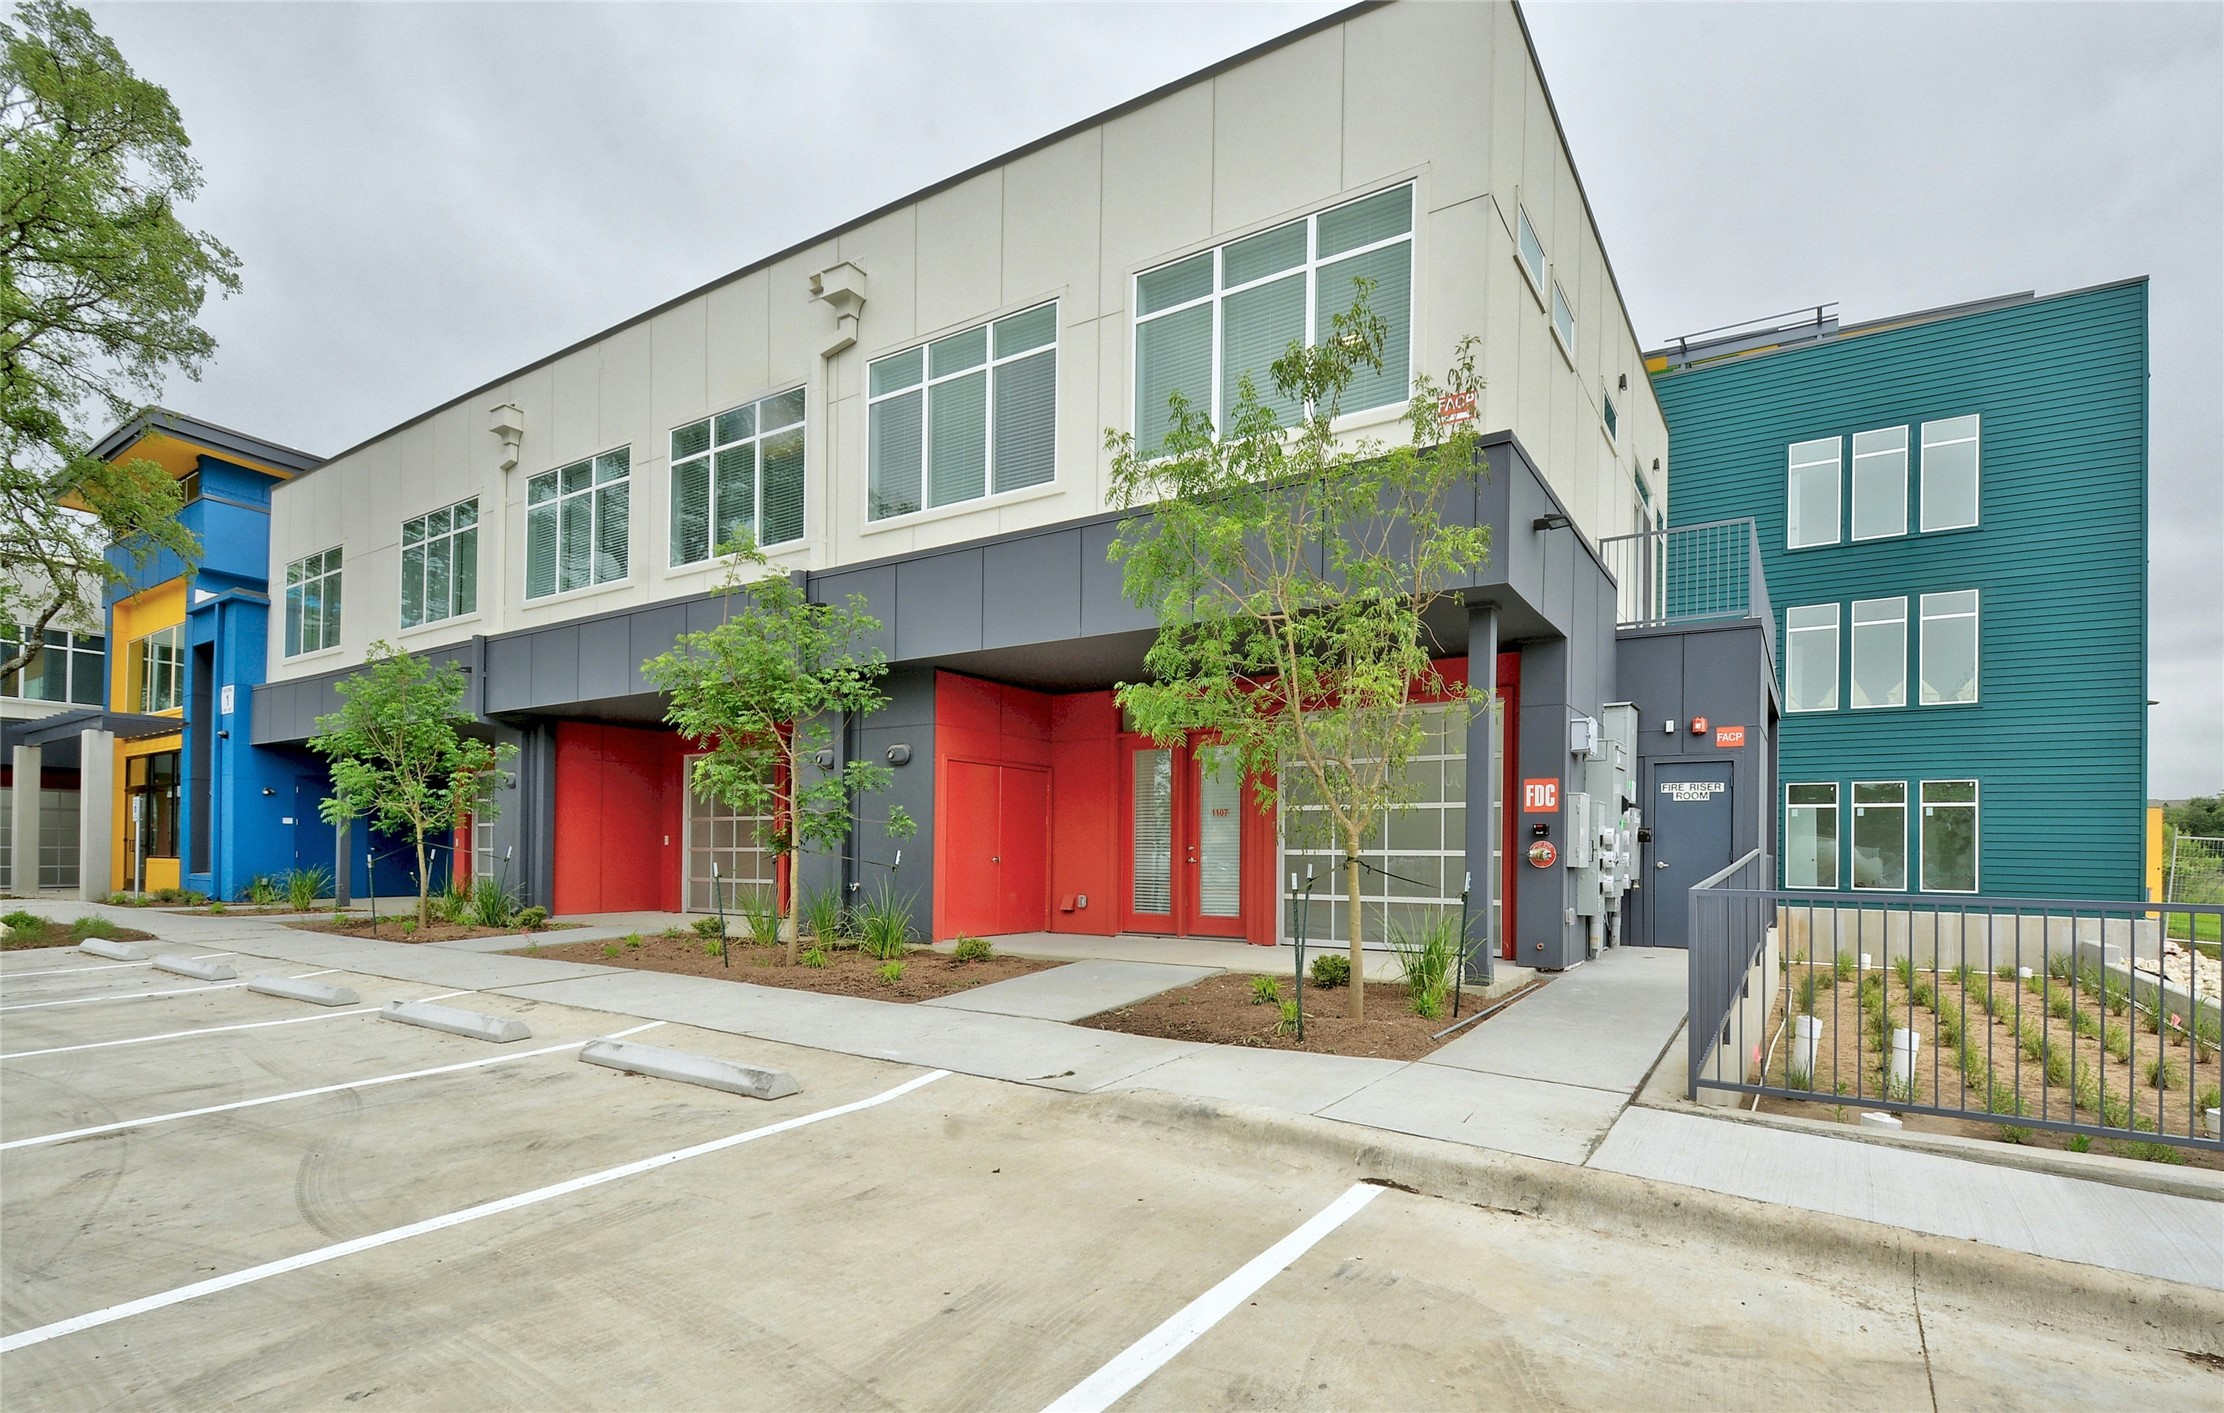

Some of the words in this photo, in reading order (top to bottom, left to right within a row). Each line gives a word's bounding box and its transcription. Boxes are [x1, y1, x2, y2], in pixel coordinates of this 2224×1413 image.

[1717, 732, 1742, 742] FACP
[1662, 783, 1685, 791] FIRE
[1690, 783, 1721, 791] RISER
[1526, 784, 1556, 807] FDC
[1675, 792, 1708, 800] ROOM
[1212, 808, 1228, 816] 1107
